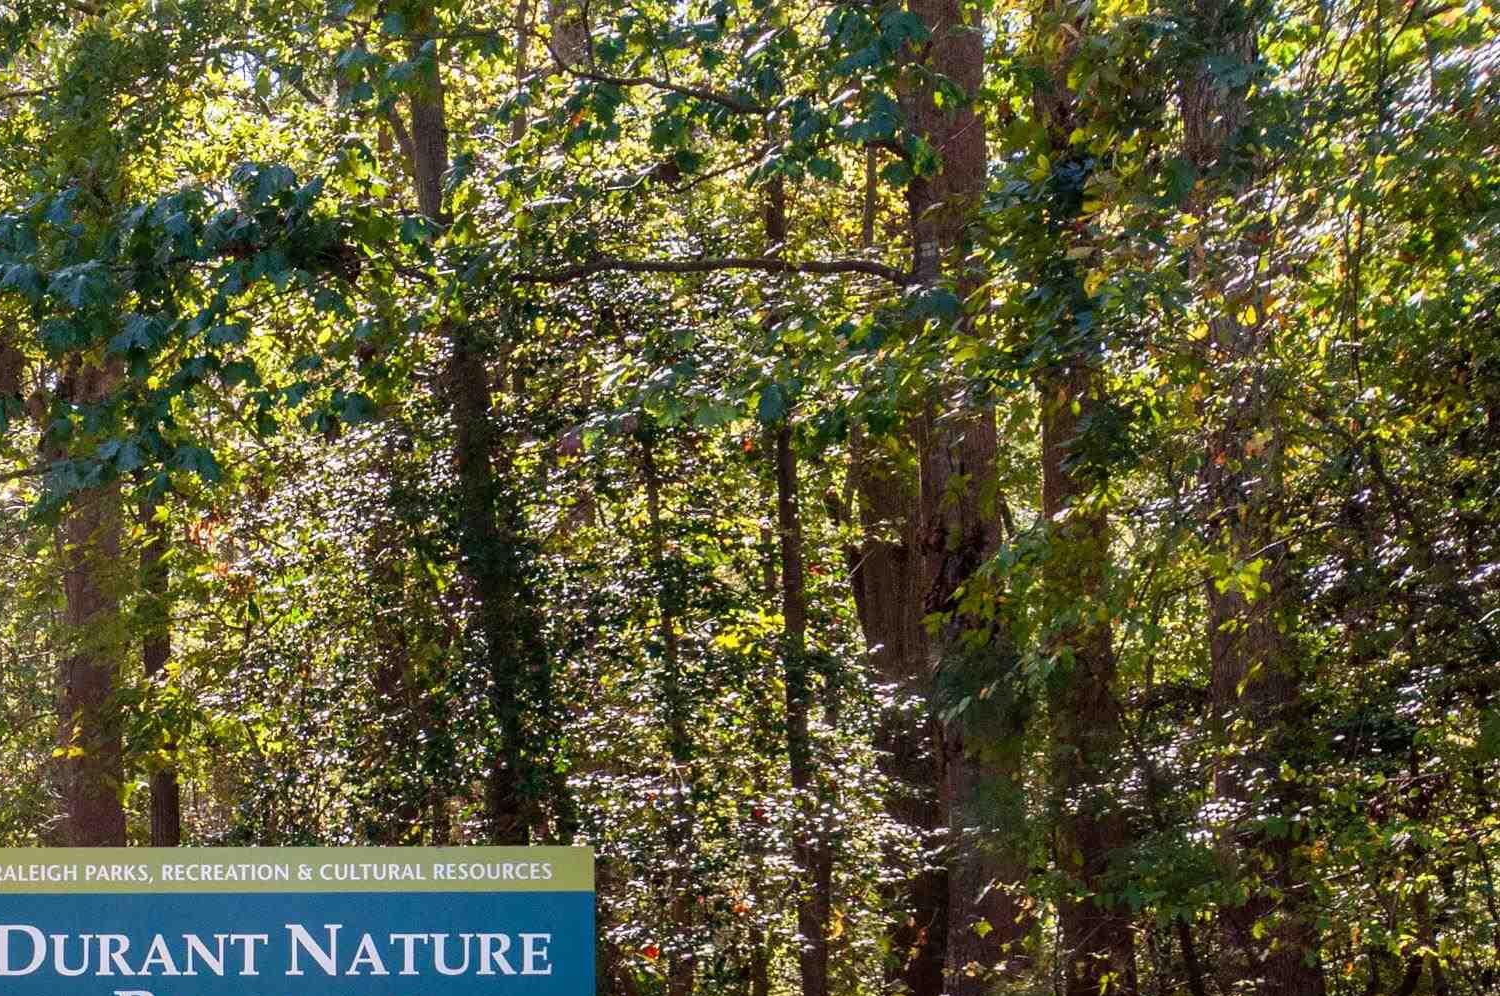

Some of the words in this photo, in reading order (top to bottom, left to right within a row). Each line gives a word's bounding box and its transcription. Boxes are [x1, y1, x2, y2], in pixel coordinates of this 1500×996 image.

[84, 864, 154, 884] PARKS,
[161, 863, 289, 882] RECREATION
[297, 863, 313, 881] &
[319, 863, 426, 881] CULTURAL
[433, 862, 552, 880] RESOURCES
[284, 923, 552, 976] NATURE
